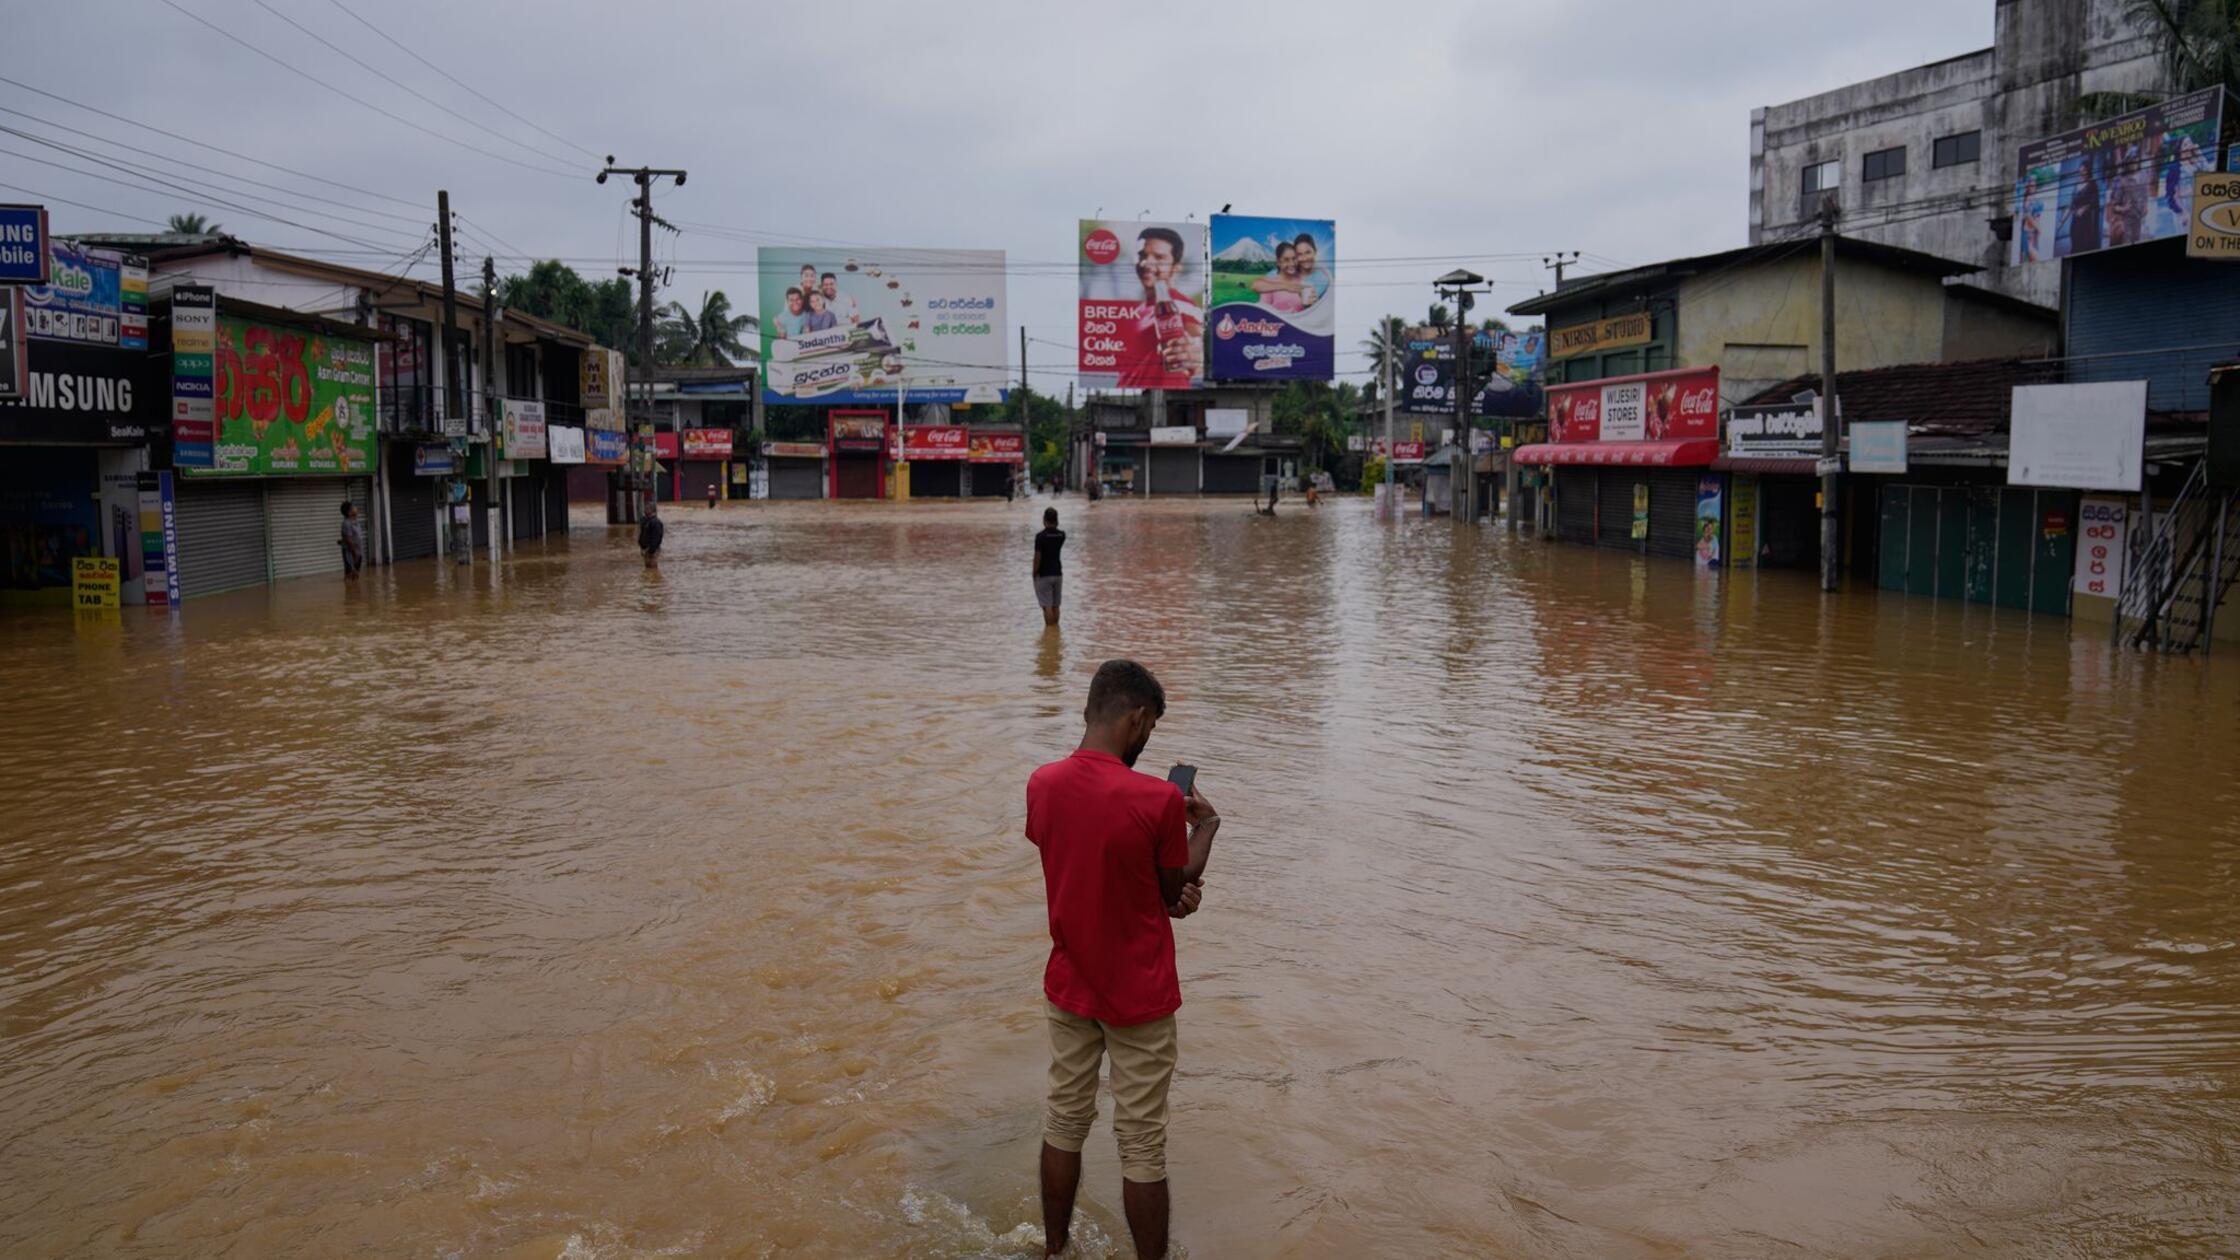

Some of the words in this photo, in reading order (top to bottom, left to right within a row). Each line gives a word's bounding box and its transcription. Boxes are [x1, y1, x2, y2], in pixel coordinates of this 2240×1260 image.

[1086, 239, 1118, 250] Coca-Cola
[2196, 236, 2215, 249] ON
[0, 246, 34, 265] bile
[182, 292, 211, 302] iPhone
[176, 314, 210, 324] SONY
[1084, 306, 1140, 319] BREAK
[1236, 318, 1285, 333] Anchor
[1604, 318, 1644, 339] STUDIO
[798, 335, 846, 350] Sudantha
[1083, 336, 1129, 351] Coke
[0, 371, 133, 412] MSUNG
[176, 382, 210, 392] NOKIA
[1606, 387, 1641, 405] WIJESIRI
[1680, 387, 1714, 416] Coca-Cola
[1574, 398, 1599, 422] Coca-Cola
[1607, 406, 1638, 423] STORES
[928, 429, 961, 443] Coca-Cola
[163, 501, 180, 600] SAMSUNG
[78, 595, 102, 605] TAB
